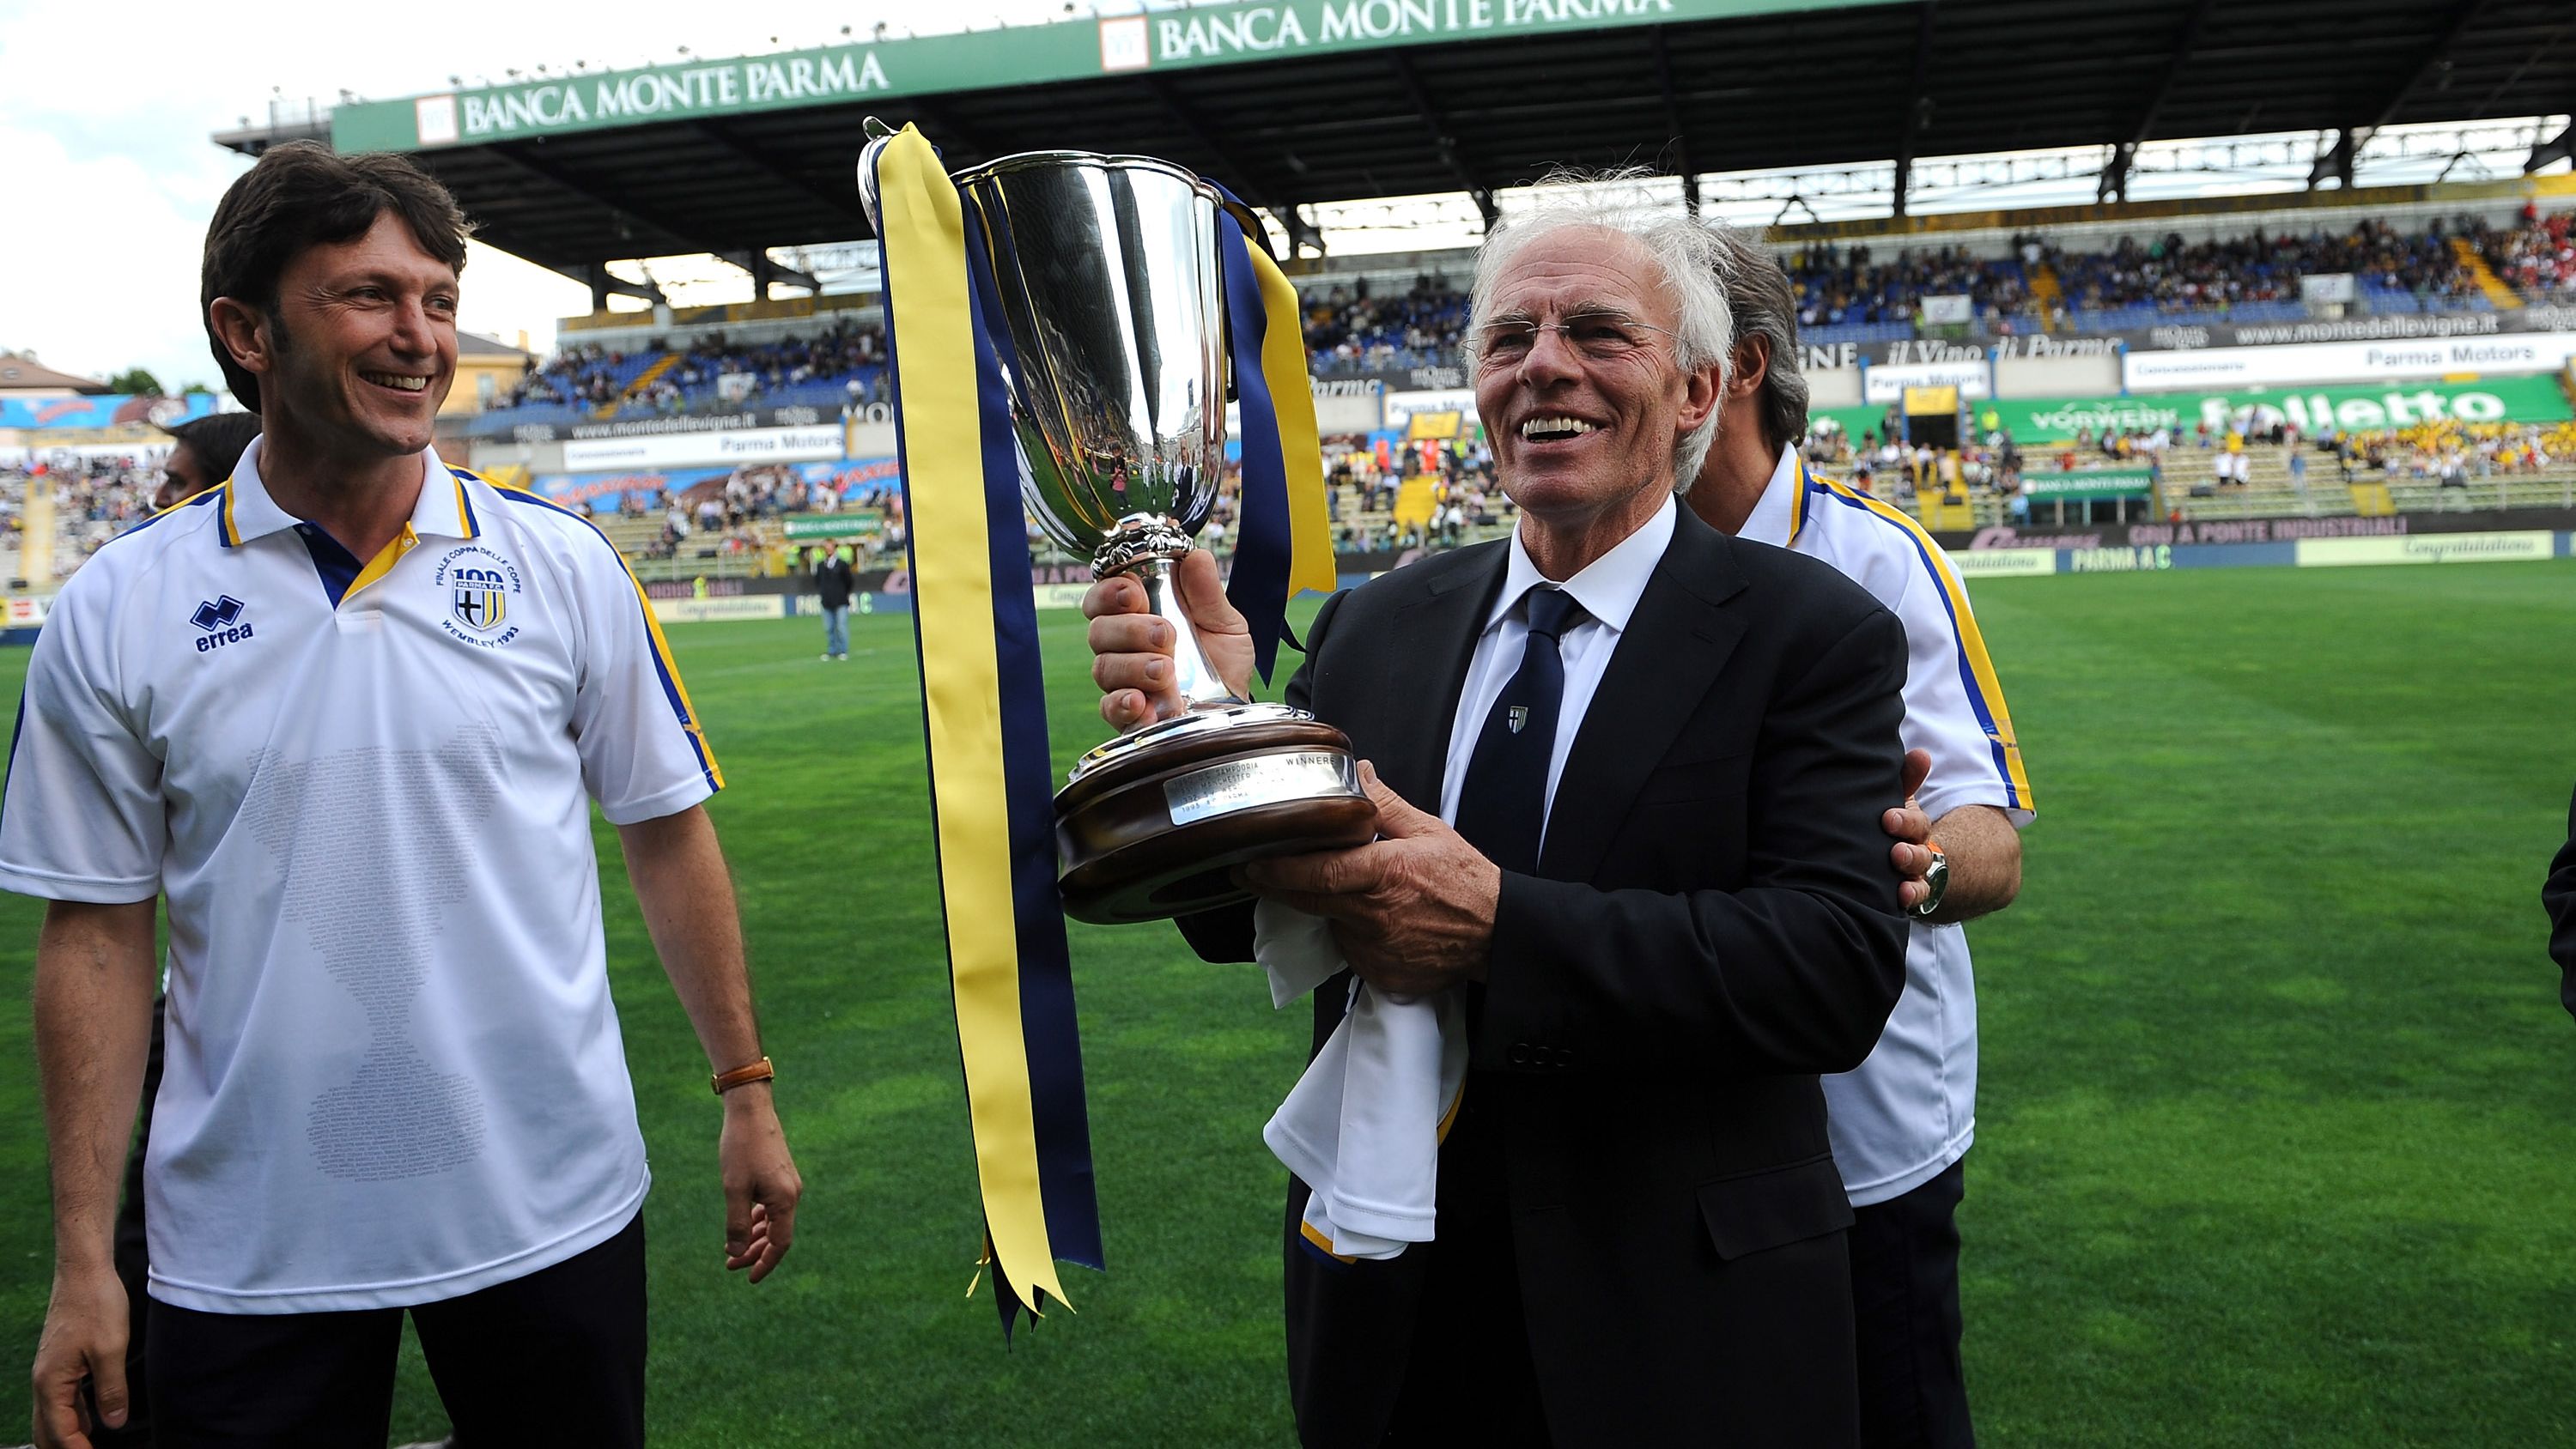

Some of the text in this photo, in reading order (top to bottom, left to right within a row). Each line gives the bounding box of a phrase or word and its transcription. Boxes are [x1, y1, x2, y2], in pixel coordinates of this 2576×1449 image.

[1157, 0, 1674, 60] BANCA MONTE PAR
[463, 50, 890, 136] BANCA MONTE PARMA
[1916, 338, 1983, 364] Vino
[2367, 349, 2443, 367] Parma
[2451, 345, 2536, 364] Motors
[436, 546, 521, 594] FINALE COPPA DELLE COPPE
[2072, 546, 2138, 572] PARMA
[453, 568, 504, 584] 100
[442, 619, 519, 648] WEMBLEY 1993
[1286, 756, 1335, 767] WINNERS
